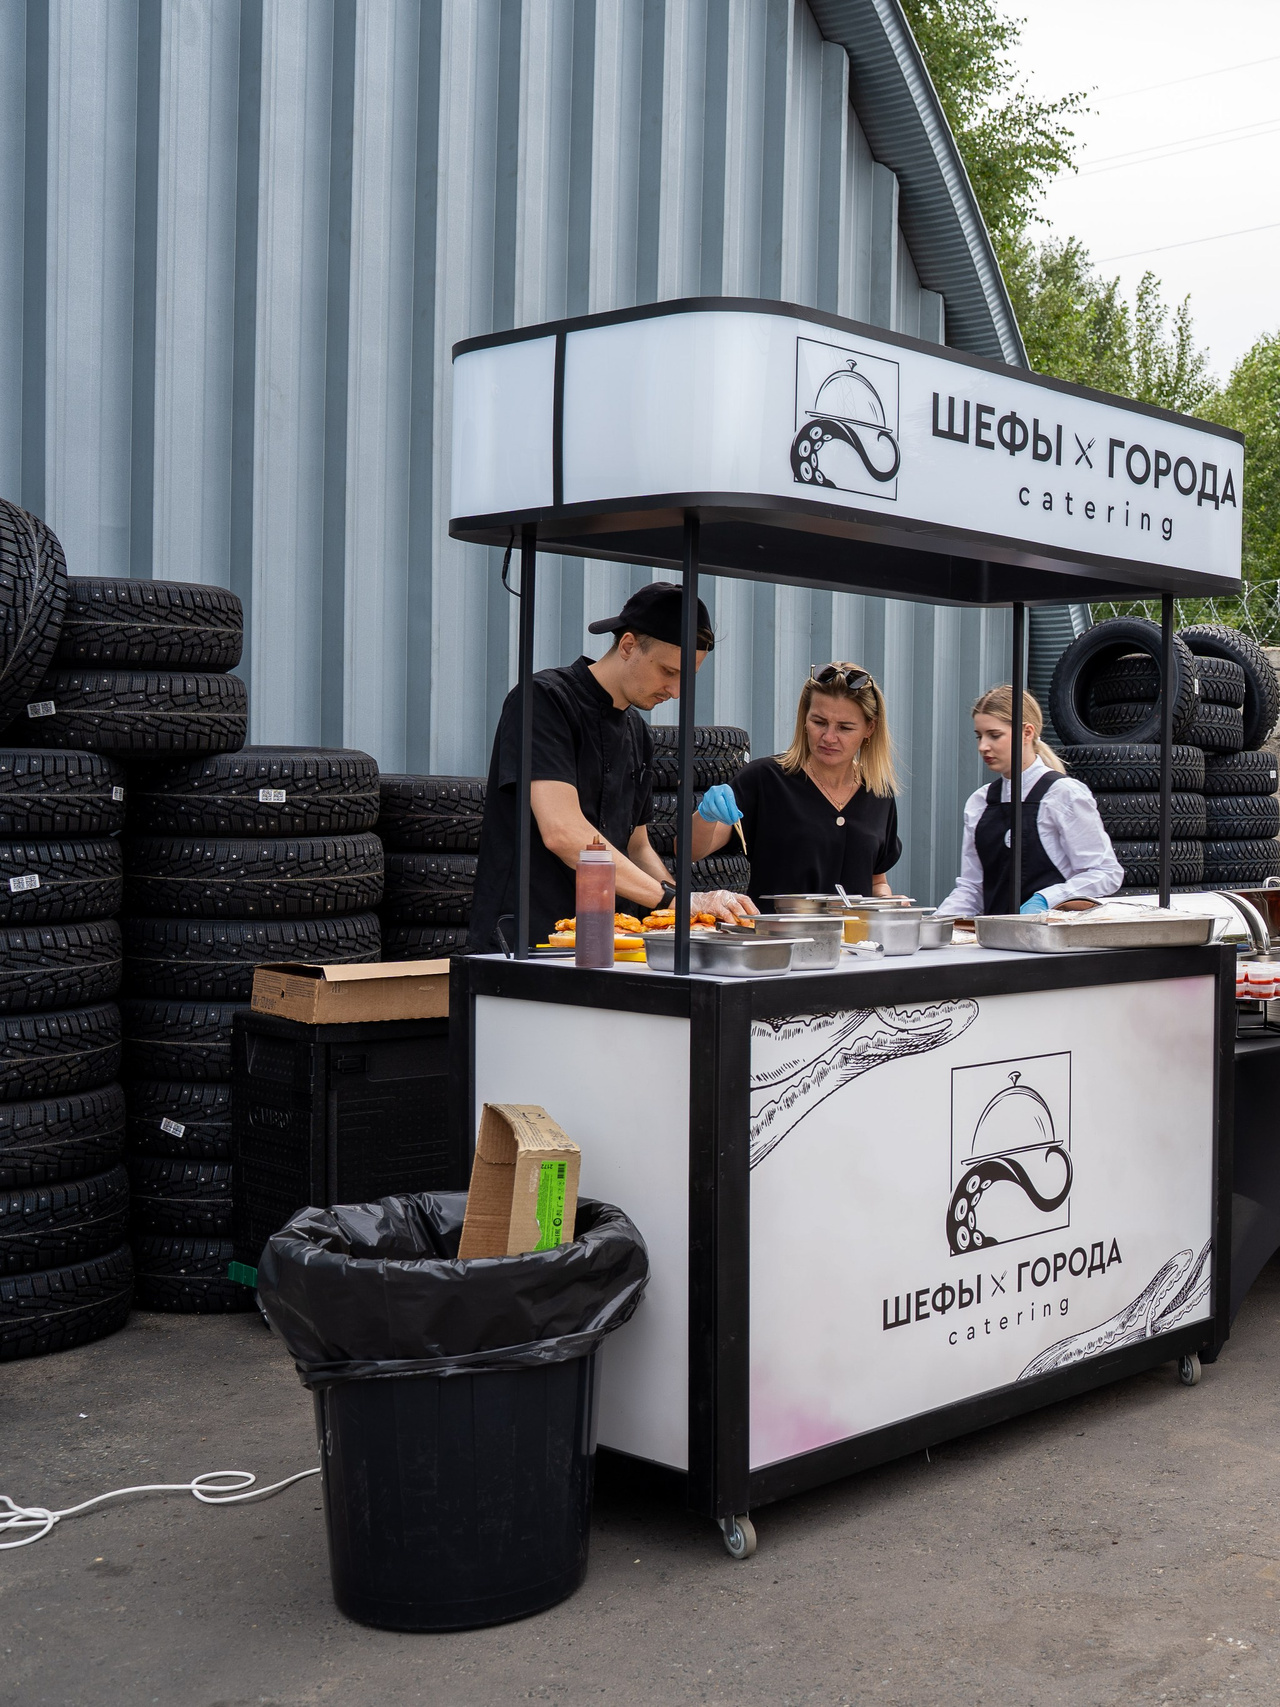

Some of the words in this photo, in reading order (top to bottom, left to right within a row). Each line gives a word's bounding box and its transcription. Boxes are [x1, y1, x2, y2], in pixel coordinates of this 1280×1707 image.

[932, 392, 1063, 466] ШЕФЫ
[1107, 438, 1238, 510] ГОРОДА
[1019, 486, 1174, 541] catering
[883, 1273, 982, 1331] ШЕФЫ
[1017, 1237, 1122, 1293] ГОРОДА
[949, 1298, 1069, 1345] catering
